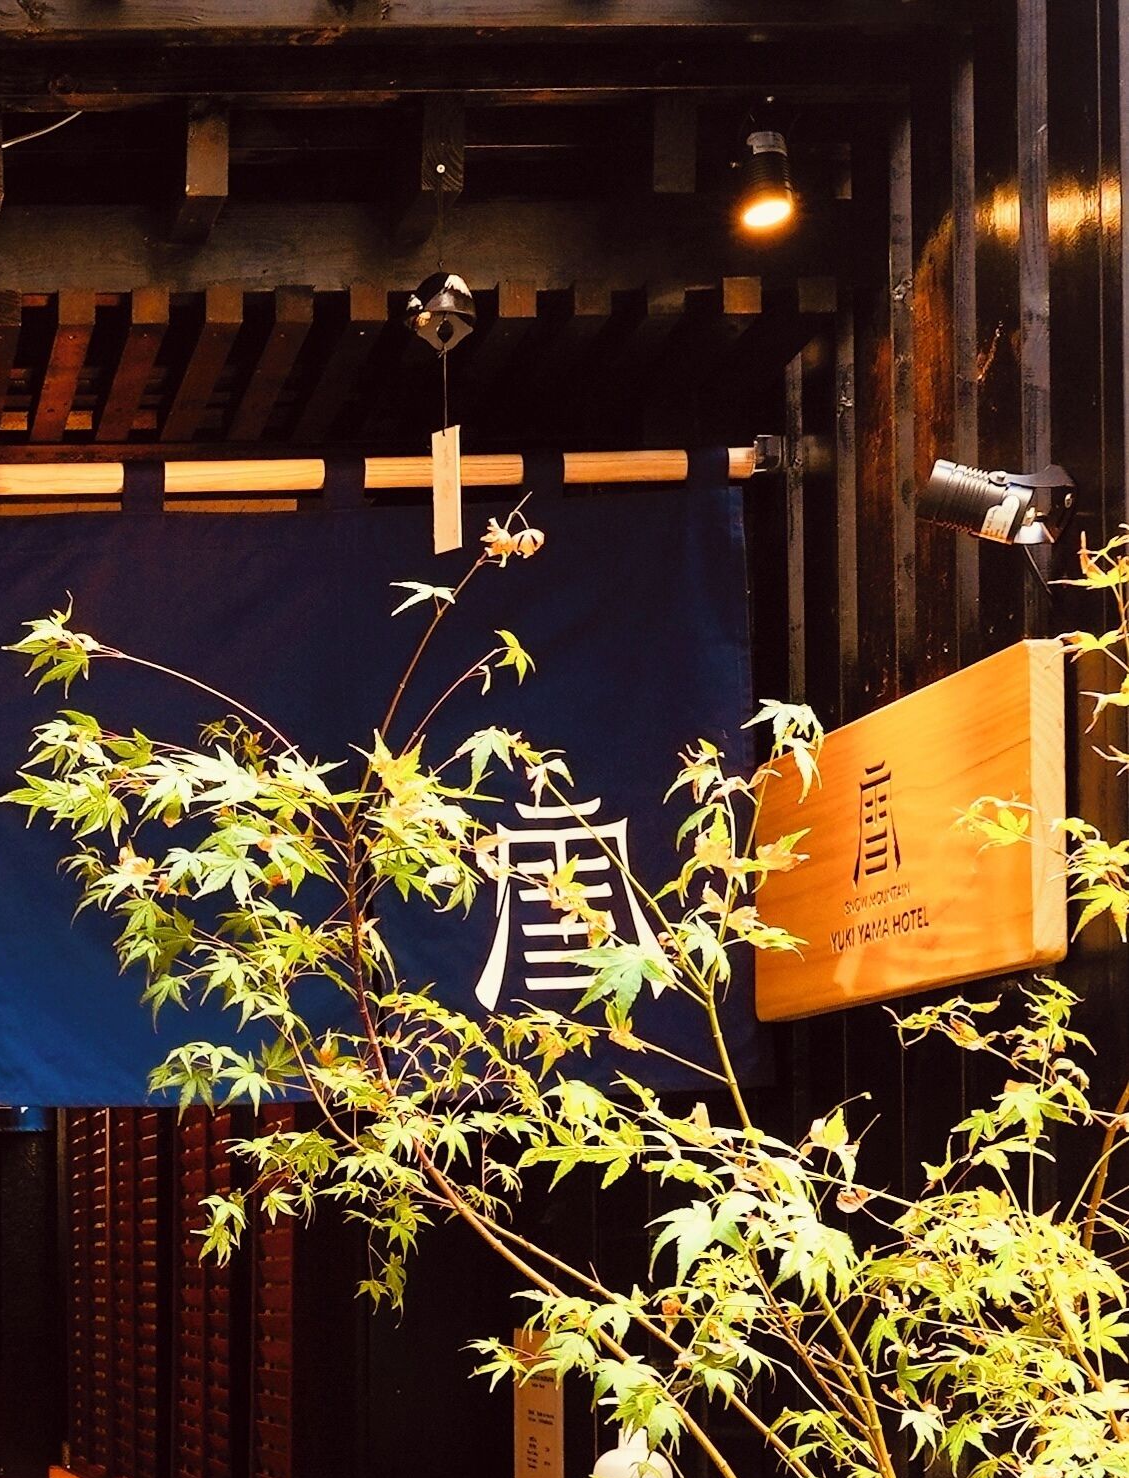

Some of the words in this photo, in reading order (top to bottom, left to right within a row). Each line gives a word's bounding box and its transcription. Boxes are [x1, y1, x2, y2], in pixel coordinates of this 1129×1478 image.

[831, 928, 856, 953] YUKI
[857, 918, 890, 945] YAMA
[892, 906, 930, 936] HOTEL
